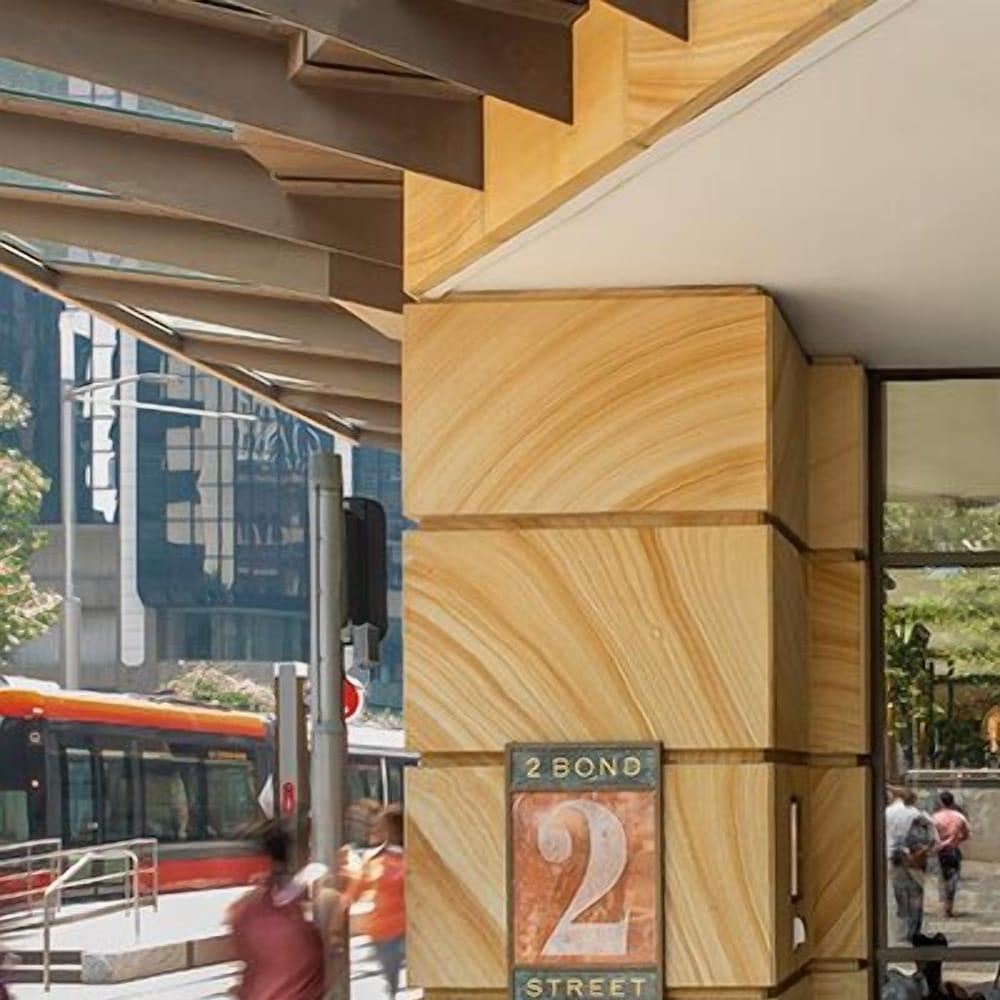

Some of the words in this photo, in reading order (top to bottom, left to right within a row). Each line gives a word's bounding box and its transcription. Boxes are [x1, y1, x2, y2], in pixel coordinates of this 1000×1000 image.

[525, 757, 541, 778] 2
[552, 757, 641, 778] BOND
[537, 799, 629, 956] 2
[525, 978, 646, 998] STREET
